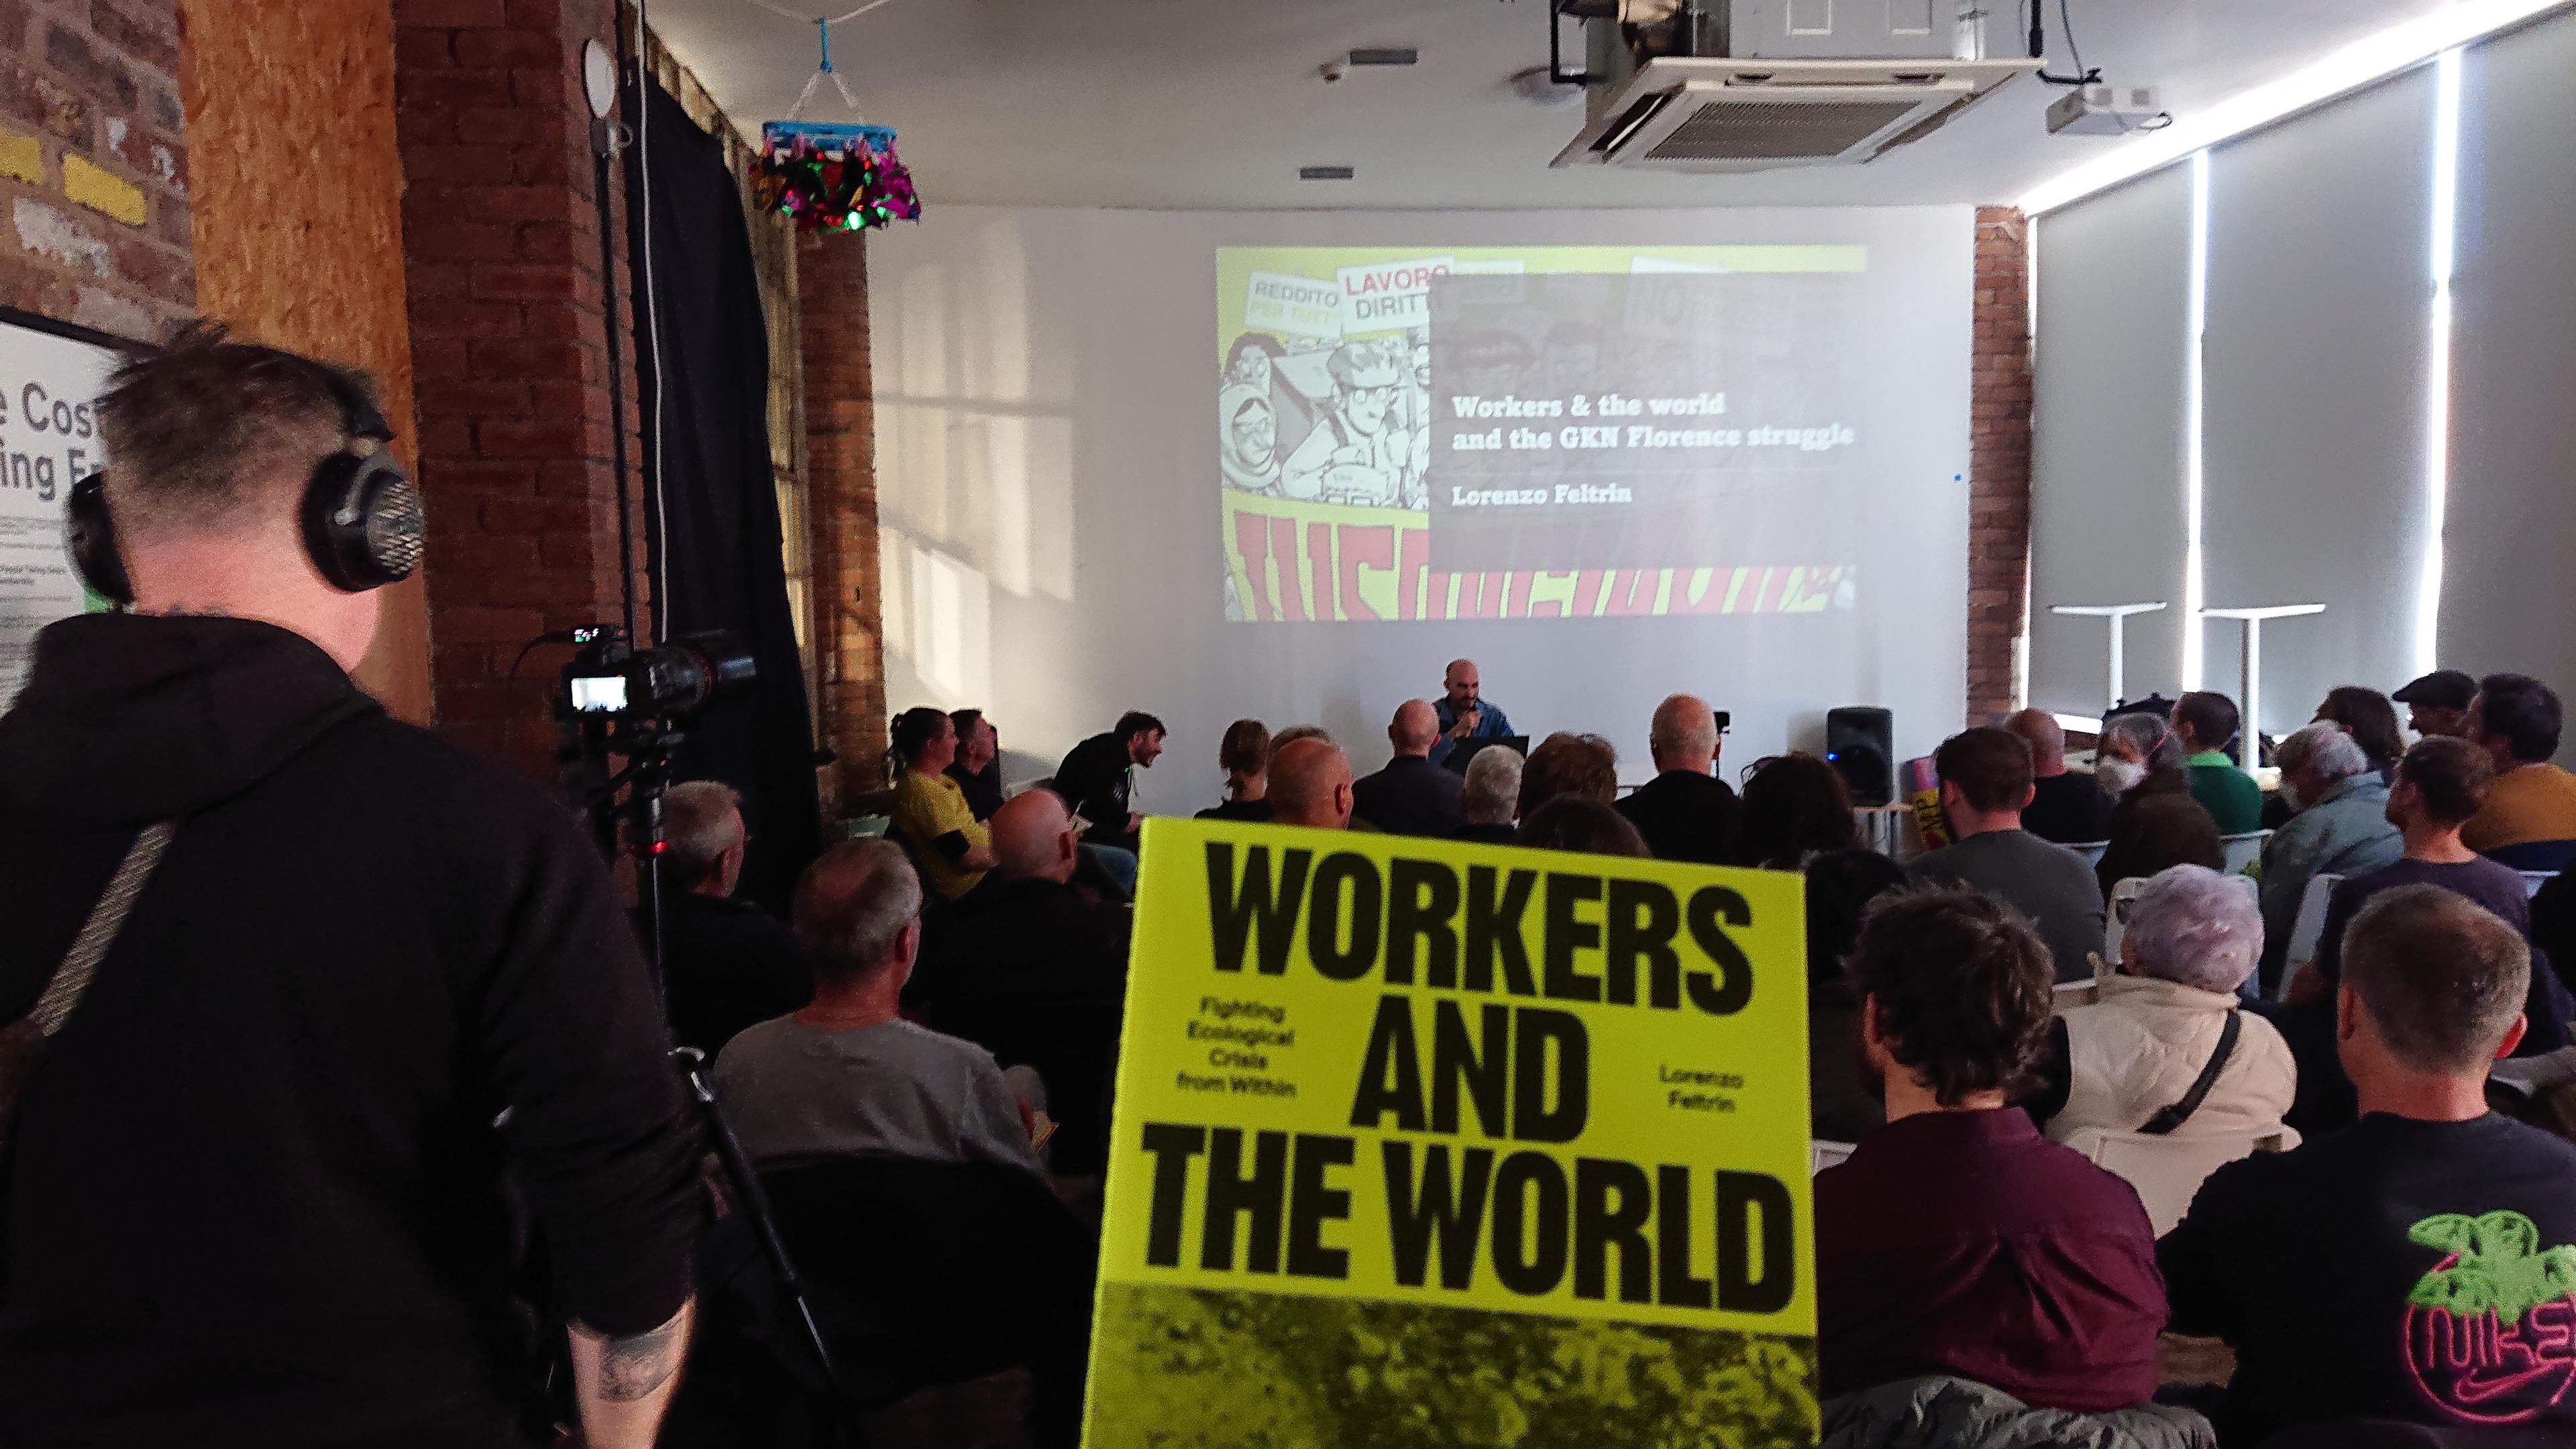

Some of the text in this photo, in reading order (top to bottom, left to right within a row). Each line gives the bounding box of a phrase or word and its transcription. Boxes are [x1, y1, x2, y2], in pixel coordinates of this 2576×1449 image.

[1255, 280, 1338, 308] REDDITO
[22, 382, 93, 440] Cos
[1452, 392, 1725, 418] Workers & the world
[1452, 423, 1855, 451] and the GKN Florence struggle
[1452, 484, 1631, 506] Lorenzo Feltrin
[1204, 841, 1754, 1016] WORKERS
[1199, 996, 1286, 1025] Fighting
[1187, 1020, 1295, 1047] Ecological
[1208, 1047, 1269, 1071] Crisis
[1349, 994, 1590, 1144] AND
[1175, 1072, 1297, 1099] from Within
[1659, 1063, 1744, 1091] Lorenzo
[1668, 1088, 1736, 1114] Feltrin
[1141, 1122, 1795, 1316] THE WORLD
